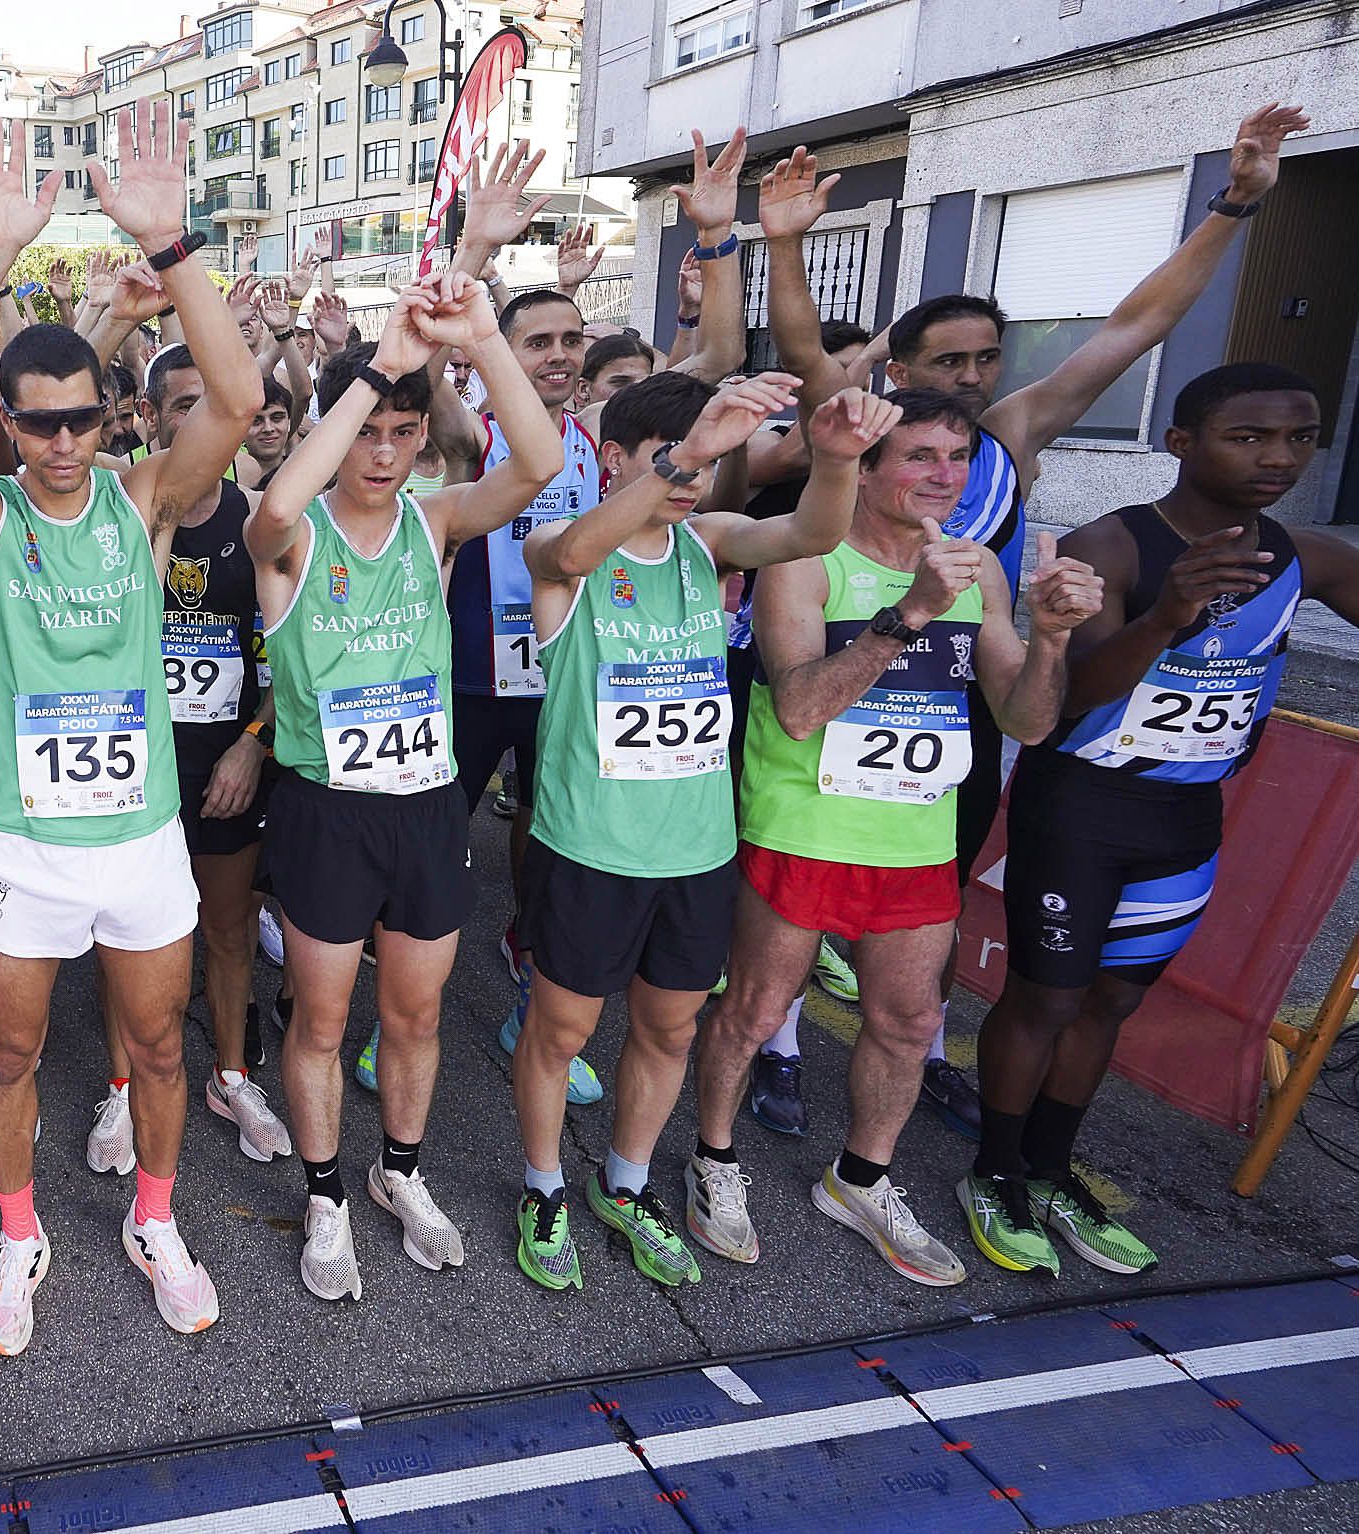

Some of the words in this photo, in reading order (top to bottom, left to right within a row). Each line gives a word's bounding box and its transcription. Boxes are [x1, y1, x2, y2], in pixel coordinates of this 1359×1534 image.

[538, 491, 561, 500] CELLO
[536, 501, 556, 509] VIGO
[8, 578, 52, 604] SAN
[39, 606, 122, 629] MARÍN
[502, 614, 532, 622] MARAT
[312, 614, 358, 633] SAN
[594, 618, 640, 639] SAN
[169, 626, 202, 635] XXXVII
[161, 634, 183, 643] ATÓN
[193, 634, 232, 645] FÁTIMA
[342, 630, 416, 653] MARÍN
[167, 645, 199, 654] POIO
[1206, 658, 1248, 668] XXXVII
[646, 664, 686, 674] XXXVII
[1157, 662, 1220, 678] MARATÓN
[1233, 665, 1267, 677] FÁTI
[609, 675, 663, 686] MARATÓN
[676, 671, 716, 682] FÁTIMA
[1195, 680, 1237, 689] POIO
[362, 685, 401, 697] XXXVII
[644, 687, 683, 699] POIO
[60, 695, 99, 705] XXXVII
[330, 697, 380, 711] MARATÓN
[393, 690, 429, 704] FÁTIMA
[886, 693, 927, 703] XXXVII
[26, 705, 78, 718] MARATÓN
[91, 702, 134, 715] FÁTIMA
[189, 703, 207, 711] FROIZ
[417, 701, 427, 709] 7.5
[915, 704, 958, 715] FÁTIMA
[363, 708, 402, 721] POIO
[1141, 692, 1260, 734] 253
[59, 719, 99, 730] POIO
[120, 716, 131, 724] 7.5
[615, 700, 721, 748] 252
[879, 715, 922, 726] POIO
[945, 716, 955, 724] 7.5
[338, 717, 439, 772] 244
[857, 729, 943, 773] 20
[34, 734, 136, 783] 135
[676, 754, 695, 762] FROIZ
[399, 771, 416, 781] FROIZ
[898, 781, 921, 789] FROIZ
[93, 791, 113, 799] FROIZ
[652, 1405, 716, 1429] Feibot
[366, 1452, 435, 1479] Feibot
[882, 1468, 949, 1494] Feibot
